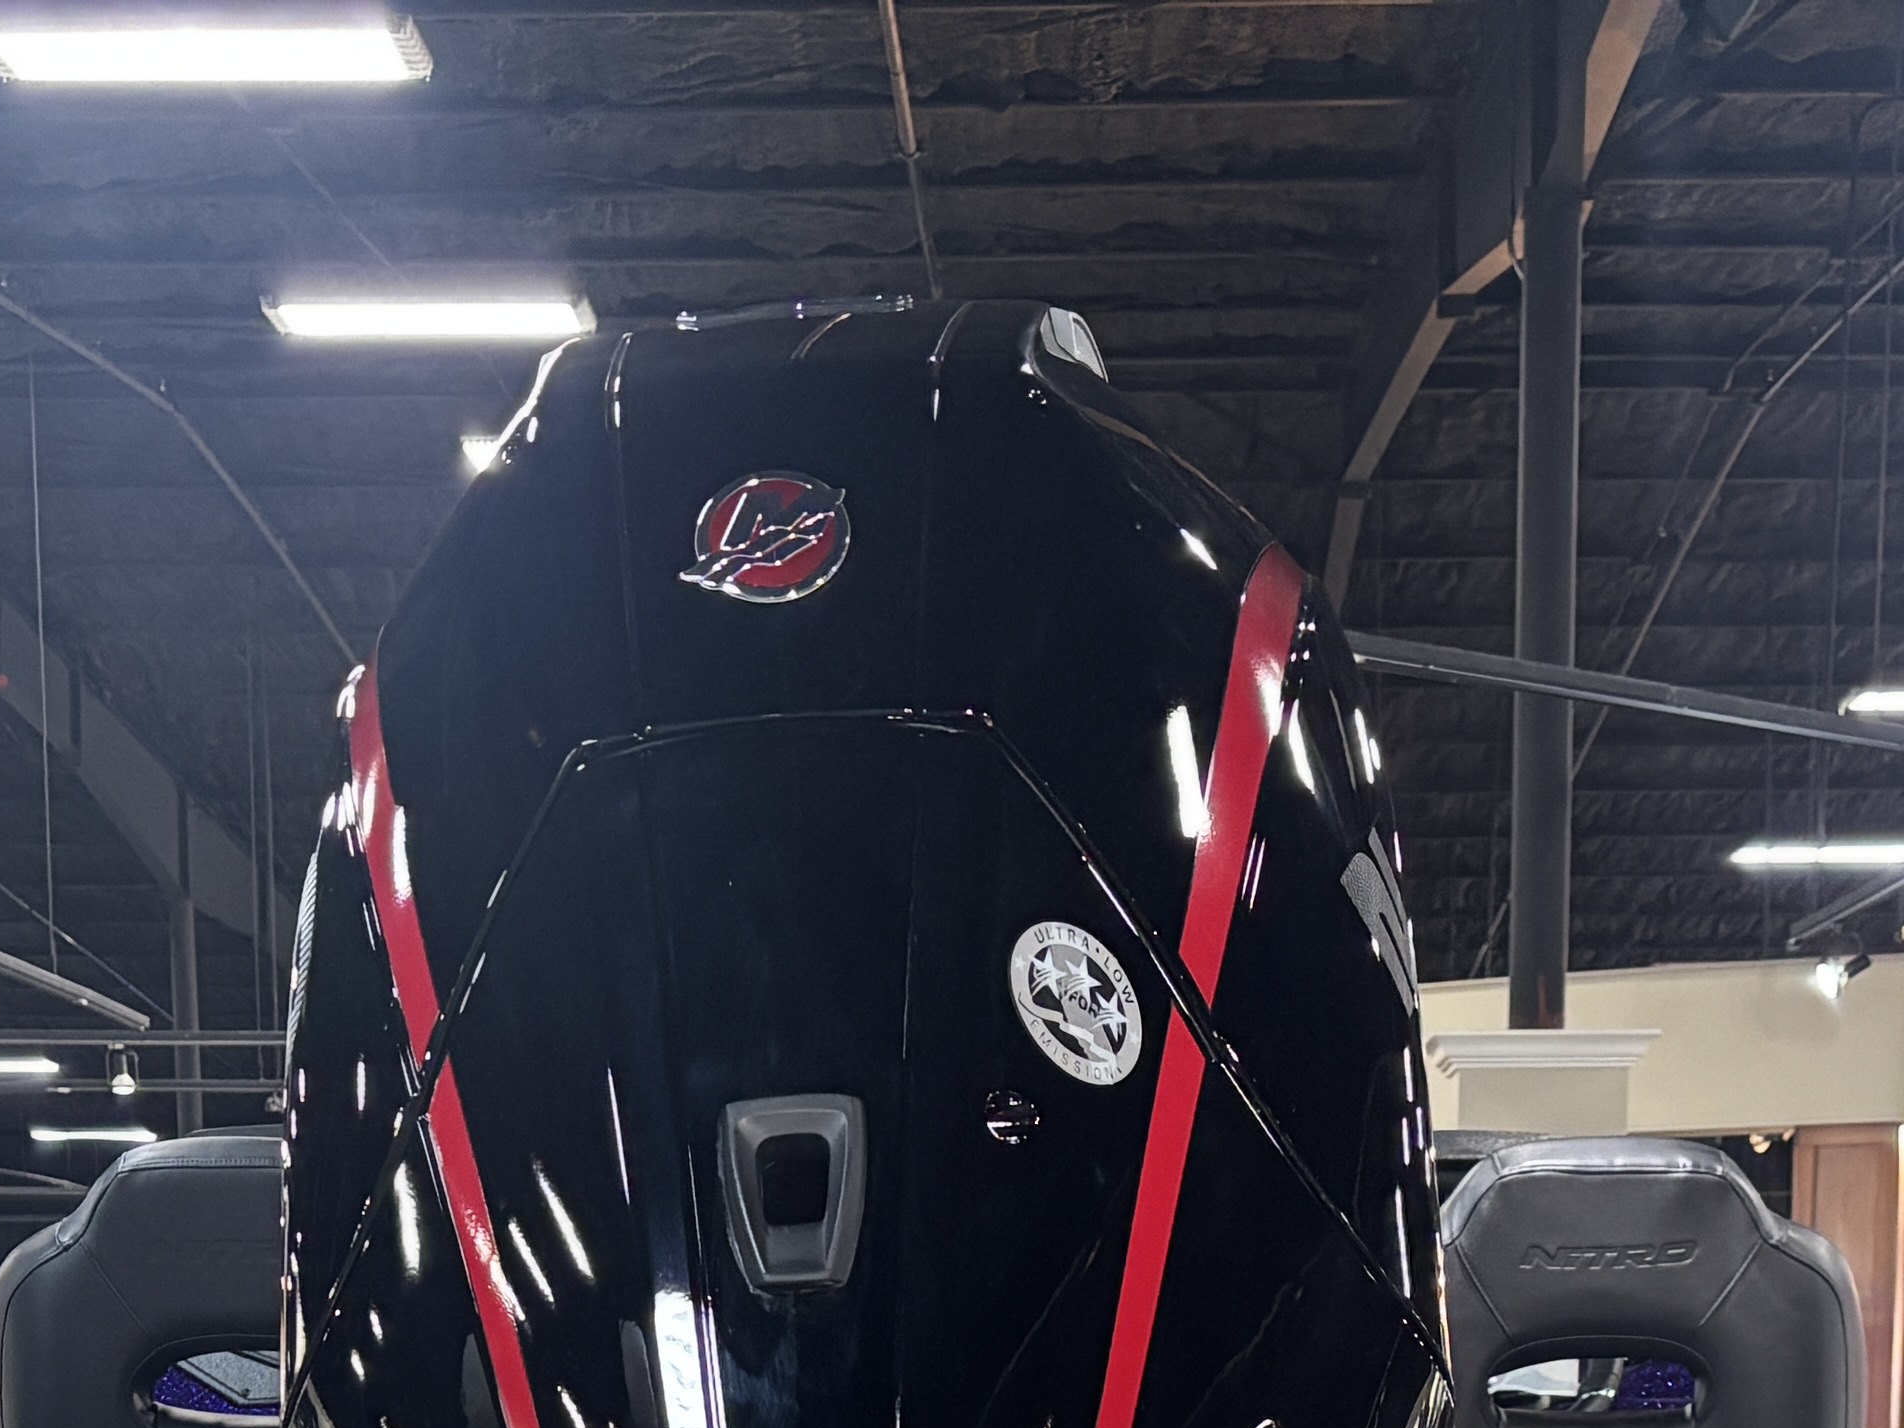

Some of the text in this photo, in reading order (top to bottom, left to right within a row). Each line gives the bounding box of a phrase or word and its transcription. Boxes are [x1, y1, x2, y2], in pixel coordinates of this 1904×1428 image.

[1034, 927, 1090, 950] ULTRA
[1104, 956, 1135, 1004] LOW
[1519, 1240, 1700, 1271] NITRO
